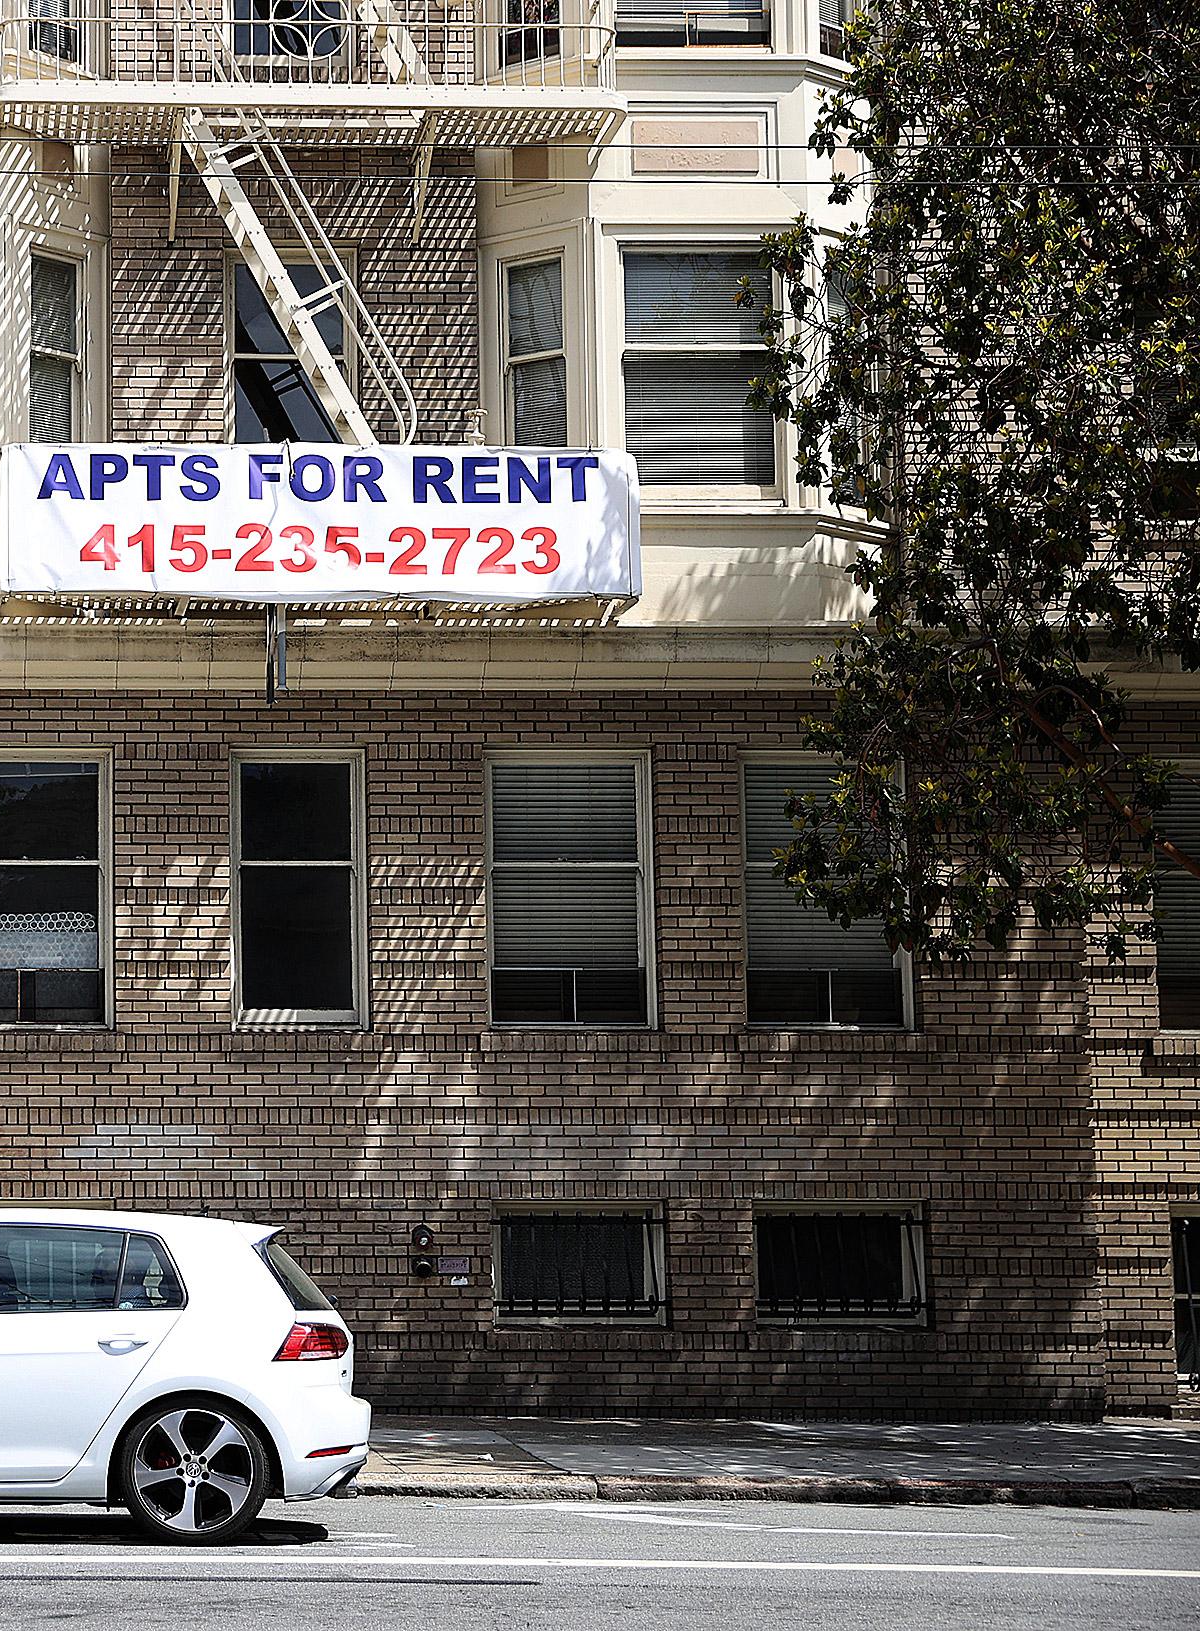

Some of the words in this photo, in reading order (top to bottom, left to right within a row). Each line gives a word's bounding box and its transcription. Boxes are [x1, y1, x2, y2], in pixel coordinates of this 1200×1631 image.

[37, 454, 221, 501] APTS
[249, 454, 387, 502] FOR
[413, 456, 599, 503] RENT
[80, 522, 561, 575] 415-235-2723
